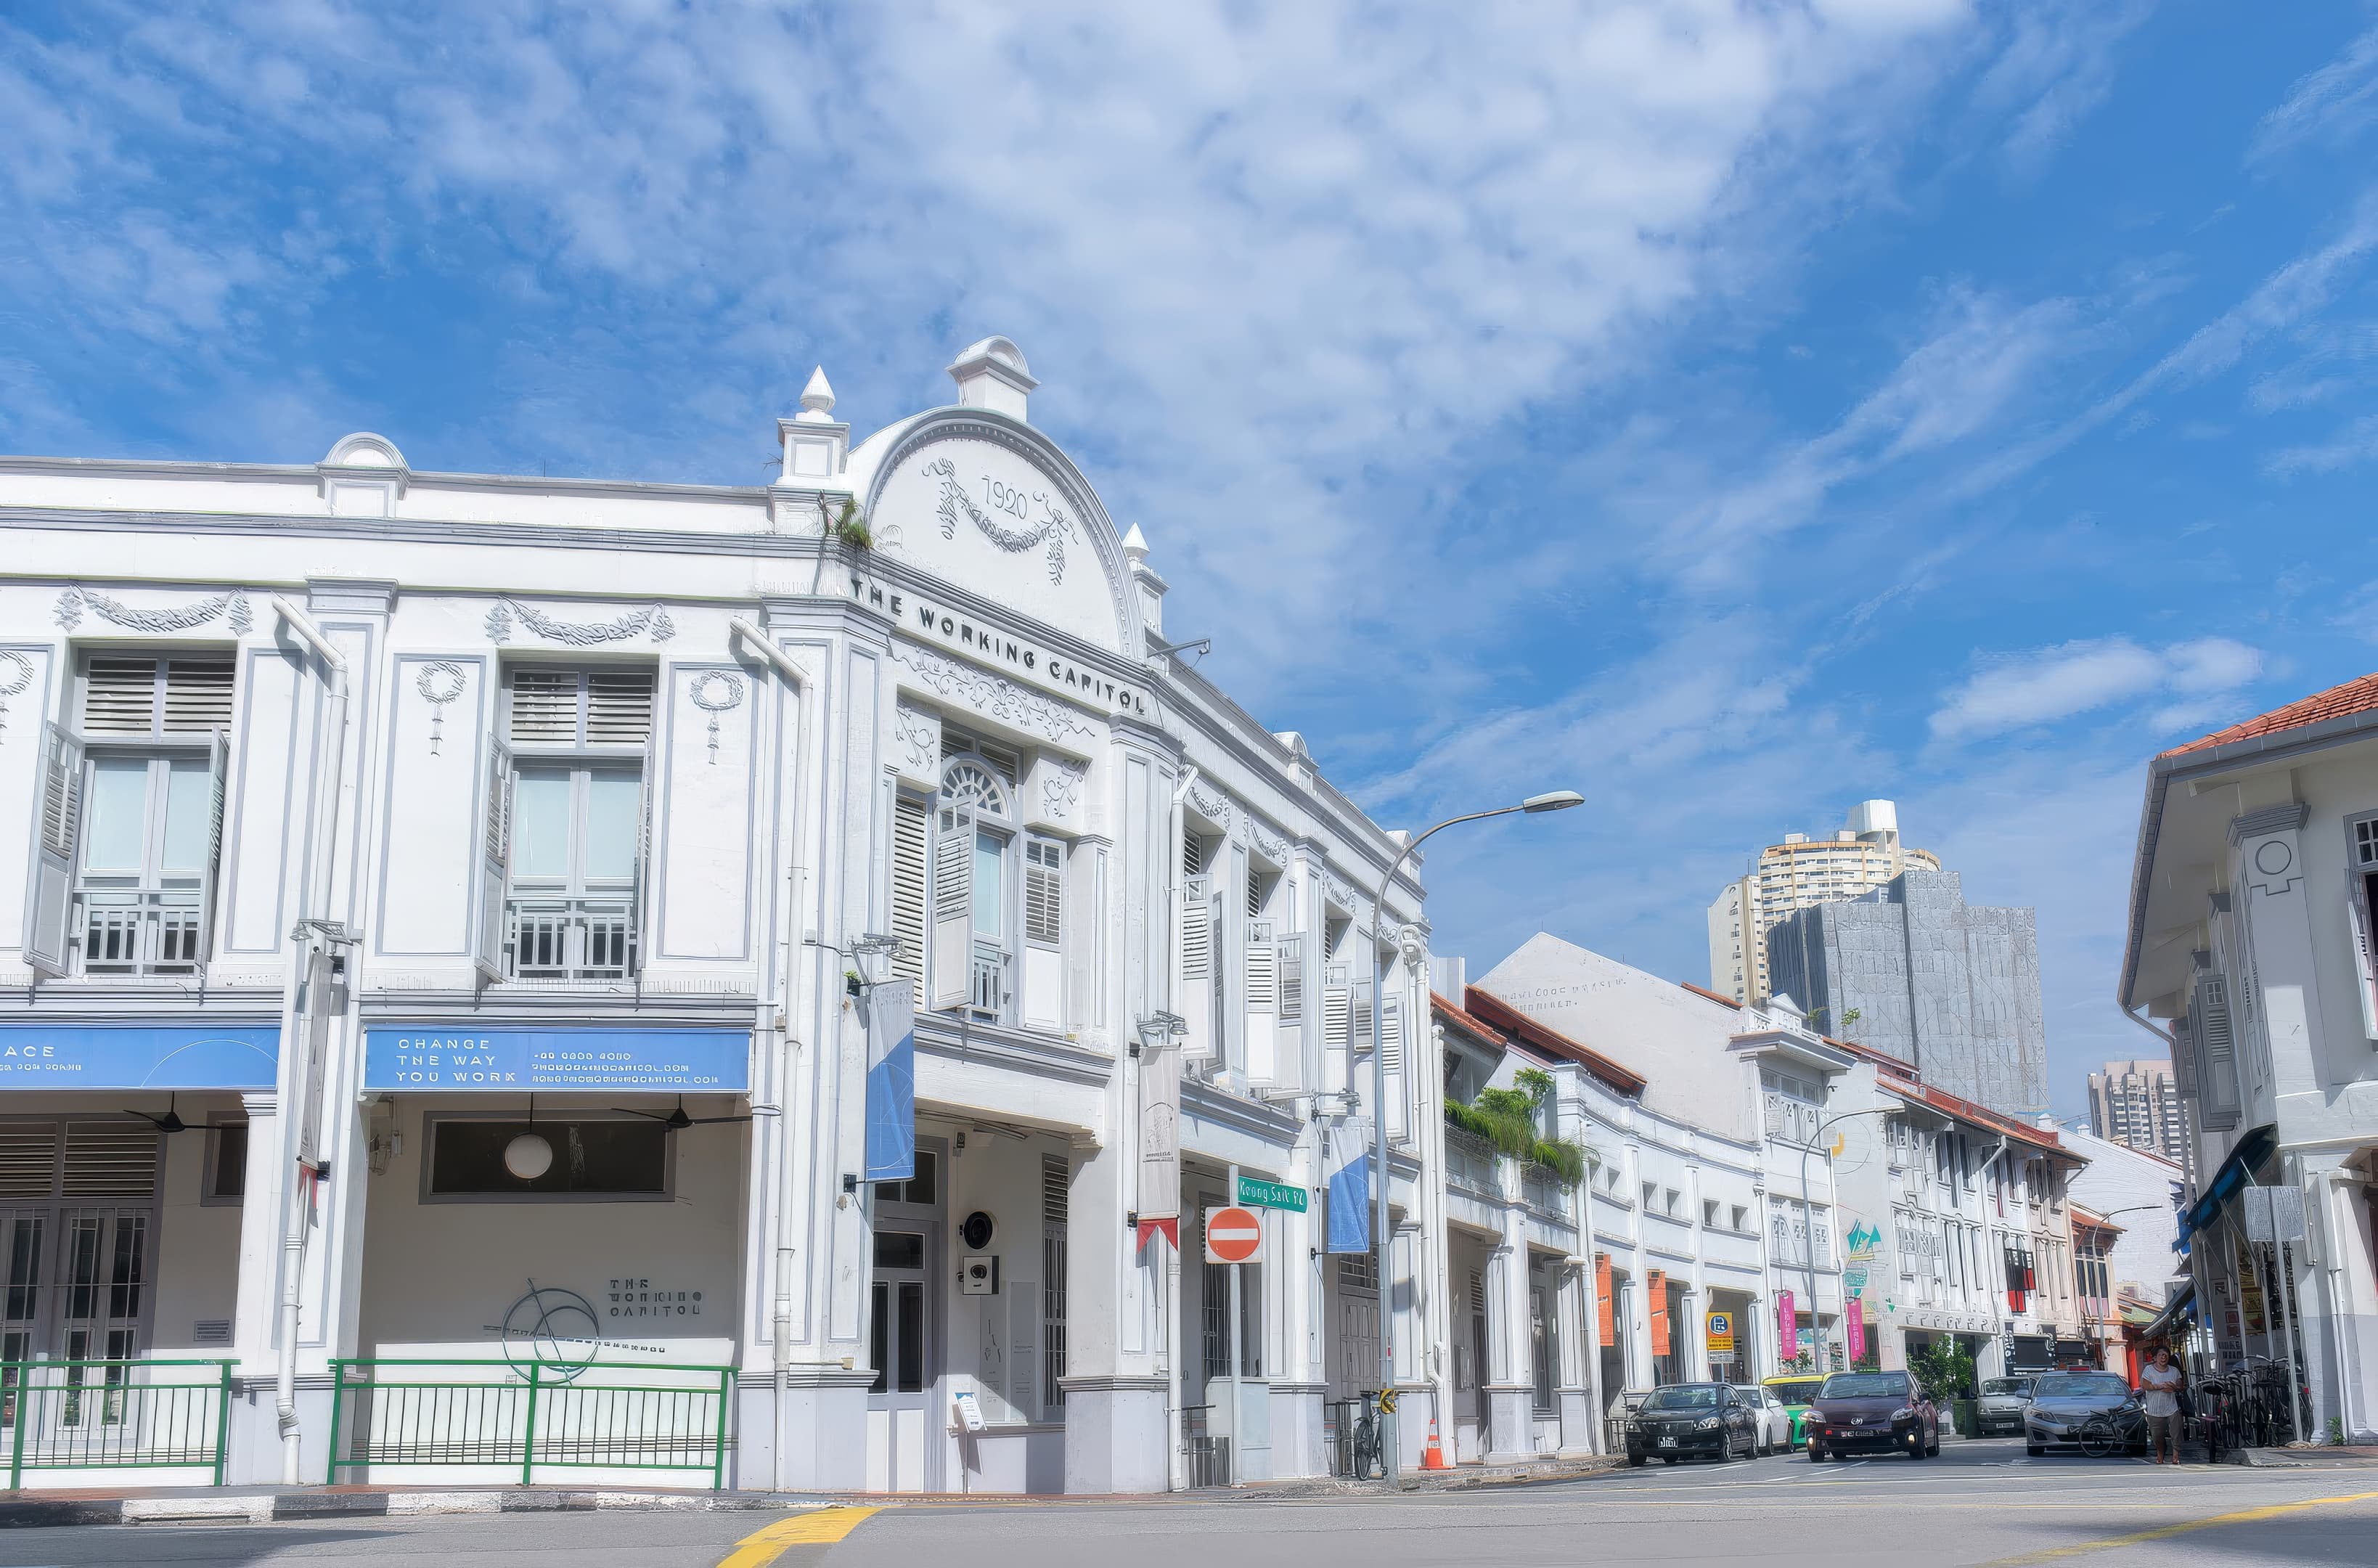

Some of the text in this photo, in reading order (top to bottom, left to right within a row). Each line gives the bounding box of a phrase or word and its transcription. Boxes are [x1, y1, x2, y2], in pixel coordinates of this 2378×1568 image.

[981, 475, 1027, 520] 1920
[850, 578, 1145, 715] THE WORKING CAPITOL
[399, 1039, 489, 1050] CHANGE
[4, 1045, 54, 1057] ACE
[452, 1055, 496, 1066] WAY
[396, 1071, 516, 1082] YOU WORK
